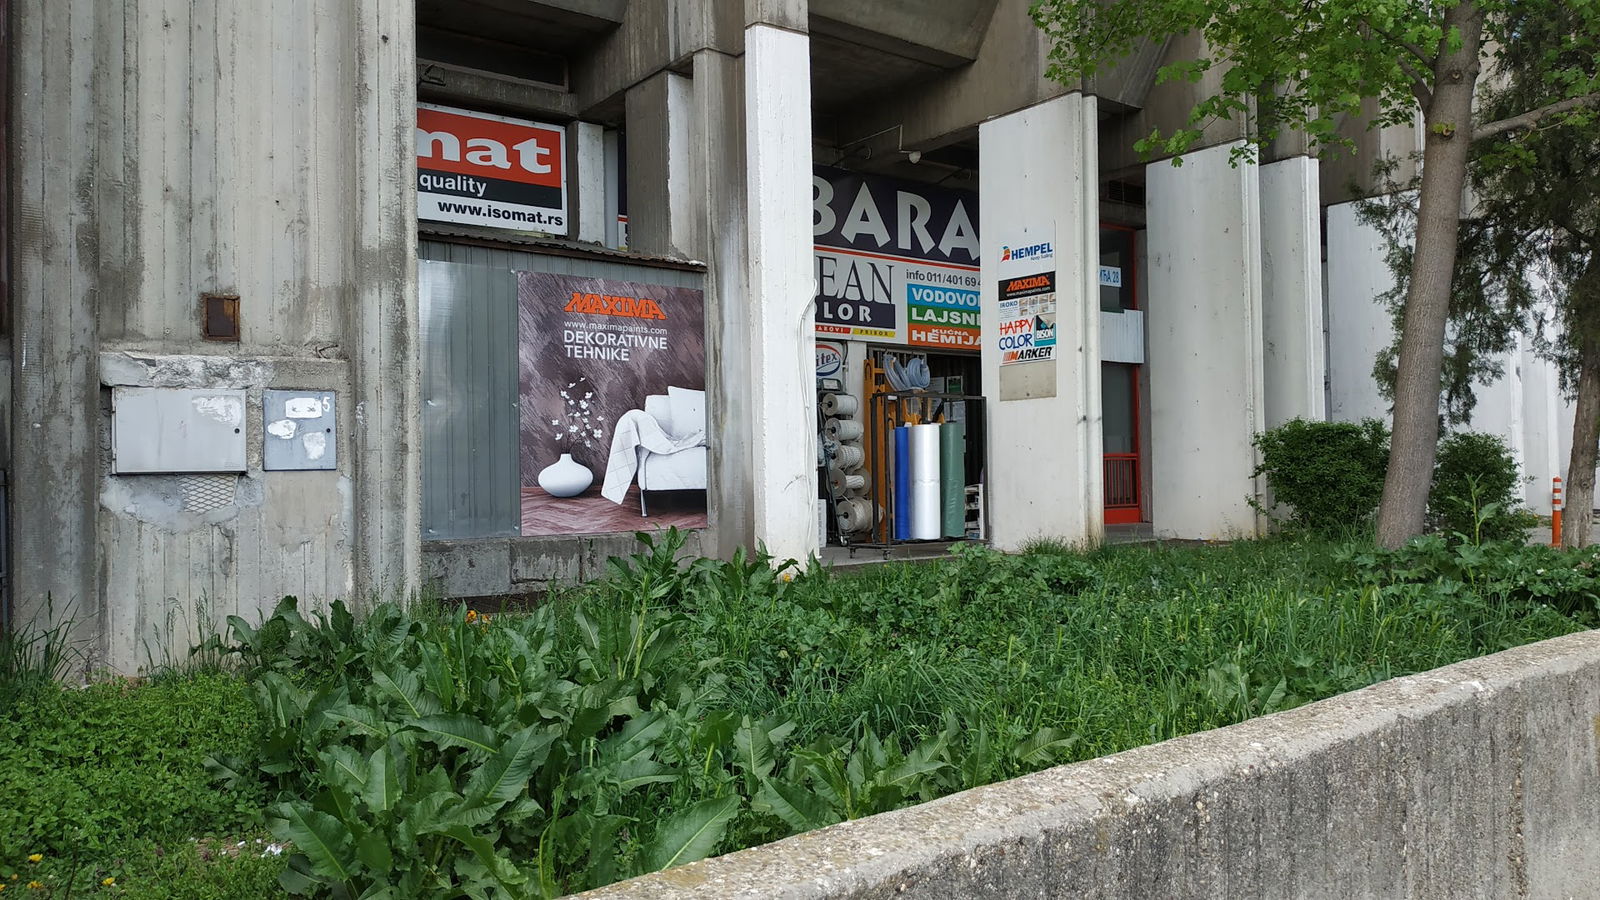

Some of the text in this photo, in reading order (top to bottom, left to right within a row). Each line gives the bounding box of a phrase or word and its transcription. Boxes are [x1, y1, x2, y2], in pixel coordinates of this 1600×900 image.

[416, 127, 552, 174] mat
[419, 172, 487, 198] quality
[437, 200, 563, 226] www.isomat.rs
[813, 174, 981, 261] BARA
[1011, 242, 1053, 260] HEMPEL
[815, 255, 895, 304] EAN
[906, 269, 925, 281] info
[926, 271, 963, 286] 011/401
[965, 276, 977, 287] 69
[1006, 275, 1051, 292] MAXIMA
[1112, 271, 1119, 283] 28
[563, 292, 668, 320] MAXIMA
[912, 287, 981, 308] VODOVO
[814, 301, 872, 323] LOR
[563, 320, 668, 335] www.maximapaints.com
[999, 317, 1035, 336] HAPPY
[1036, 328, 1054, 339] BISON
[563, 330, 668, 350] DEKORATIVNE
[999, 333, 1033, 350] COLOR
[564, 345, 630, 361] TEHNIKE
[1003, 346, 1052, 361] MARKER
[322, 396, 330, 412] 5
